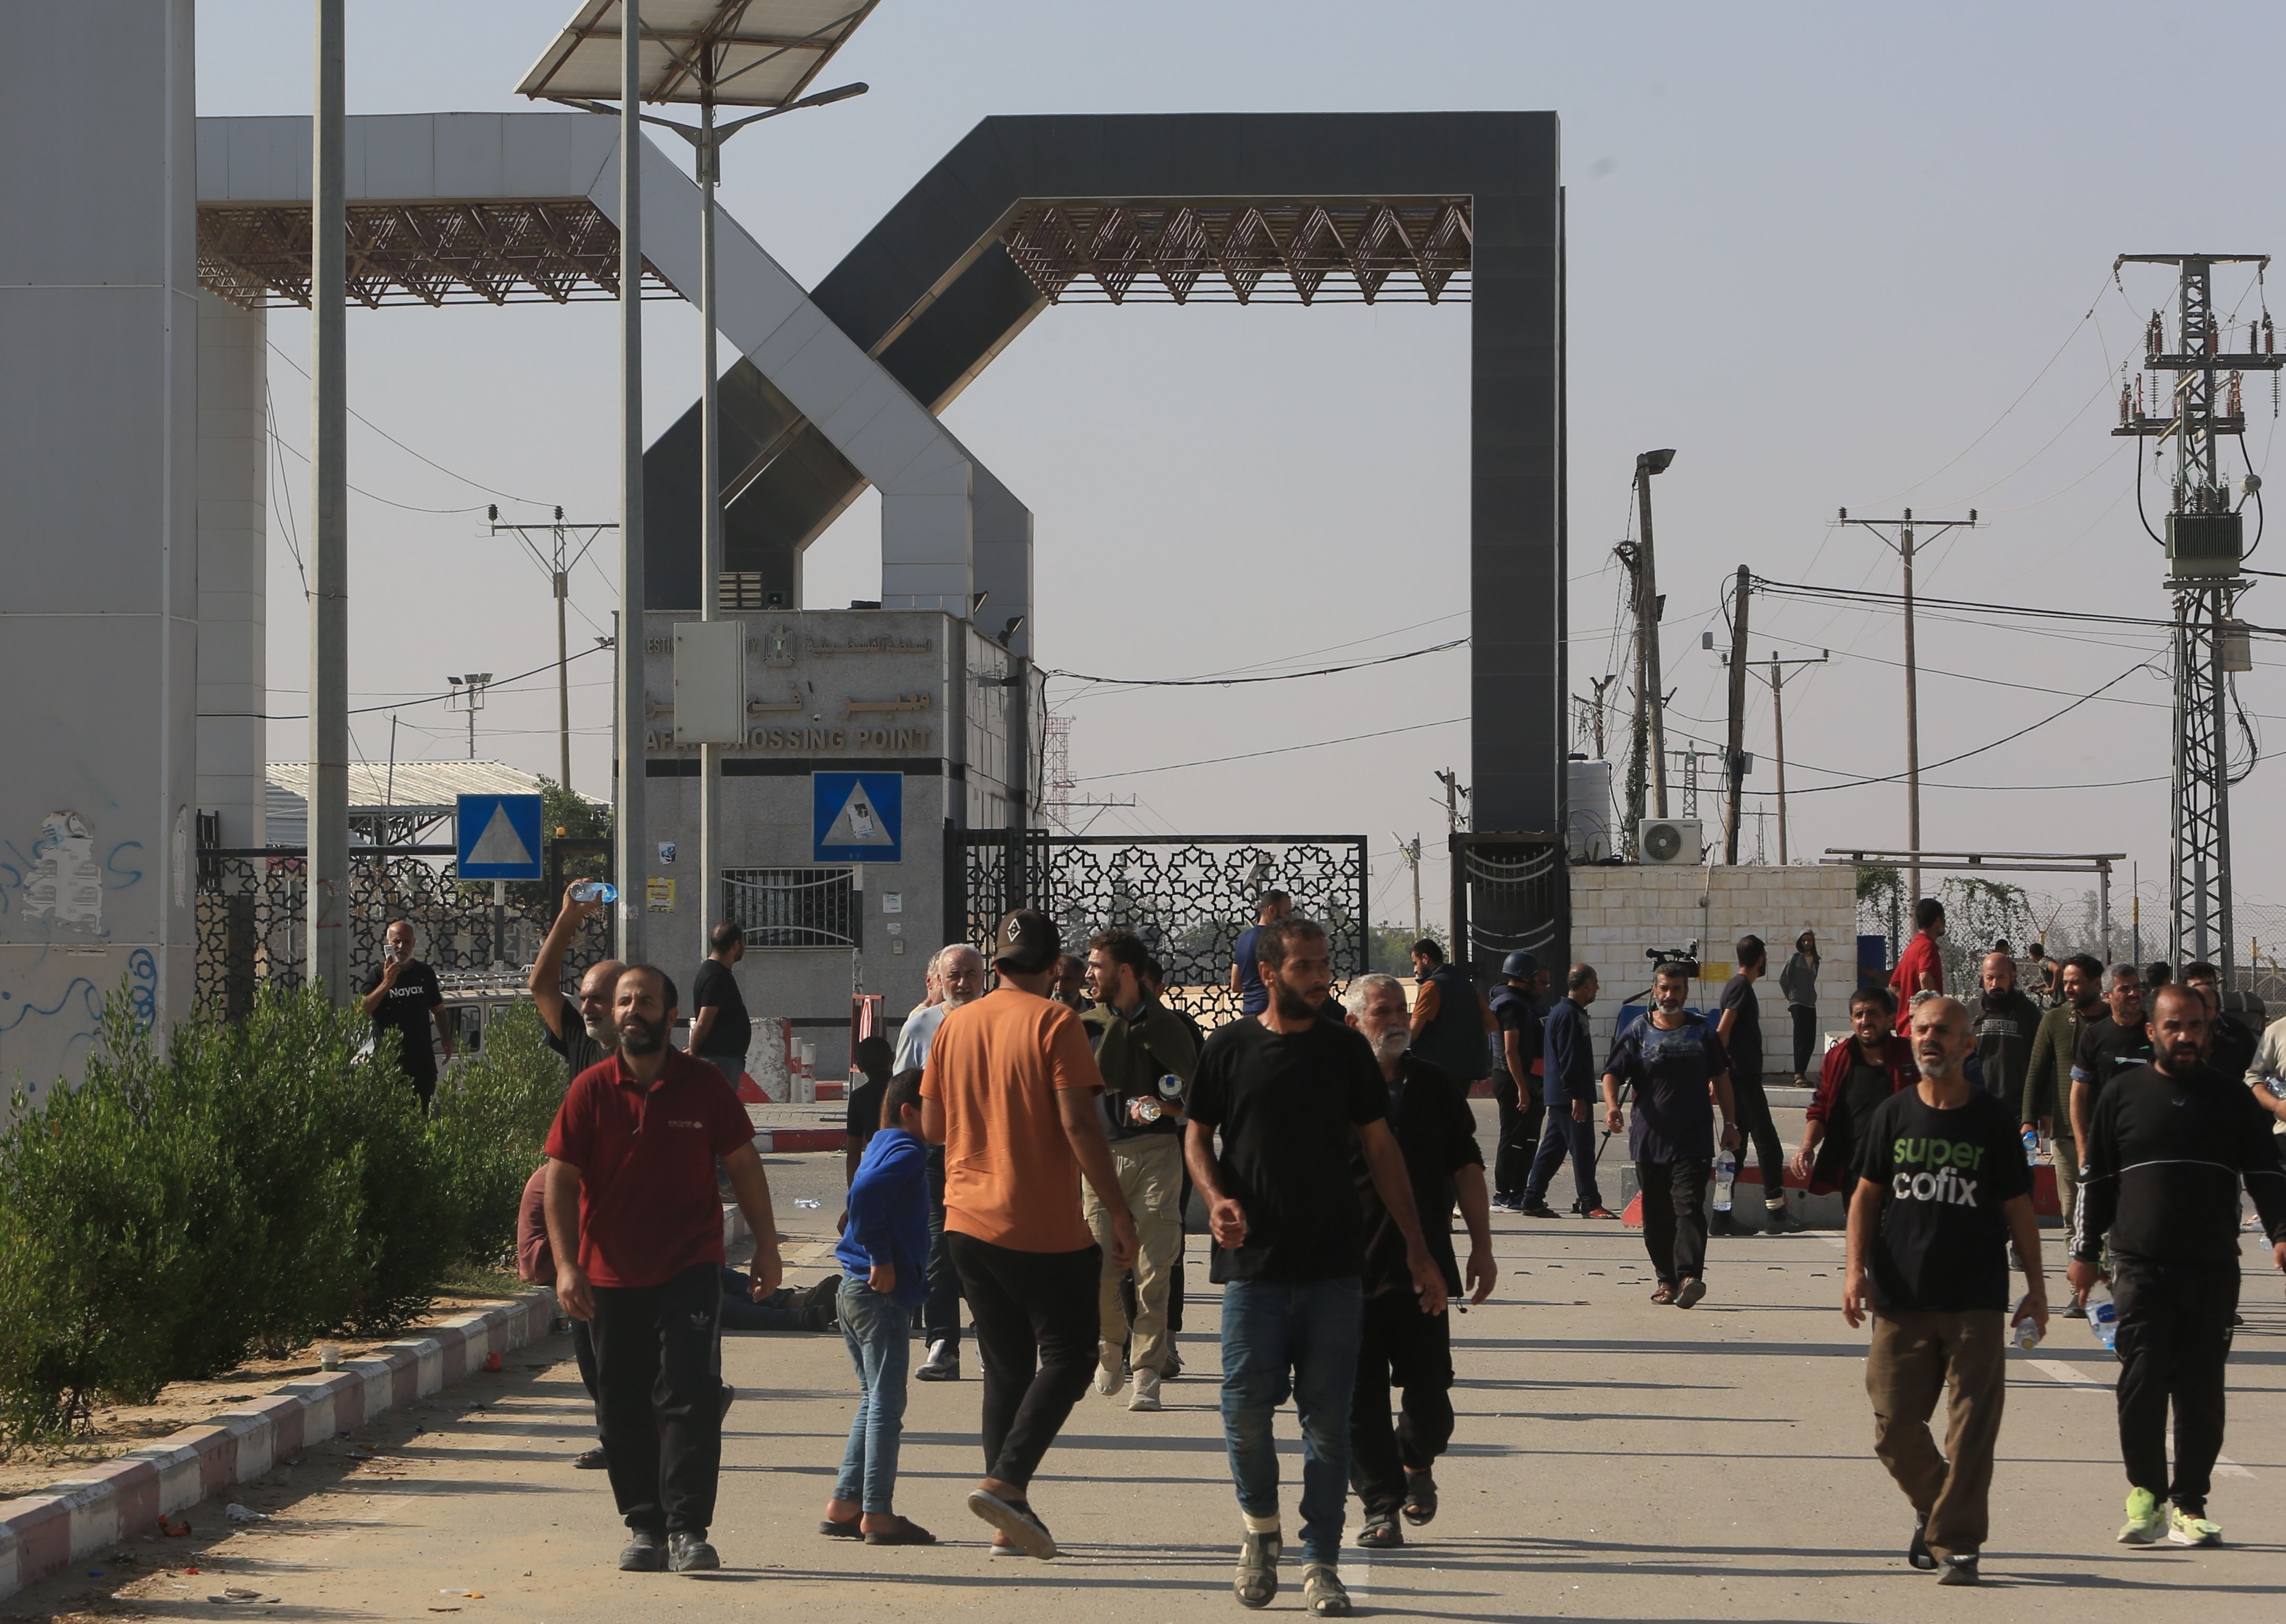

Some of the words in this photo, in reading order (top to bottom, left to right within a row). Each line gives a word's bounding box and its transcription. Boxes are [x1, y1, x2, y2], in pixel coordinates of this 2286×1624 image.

[839, 691, 931, 721] معبر
[857, 728, 931, 750] POINT
[389, 986, 424, 999] Nayax
[1894, 1138, 1984, 1170] super
[1892, 1166, 1978, 1208] cofix
